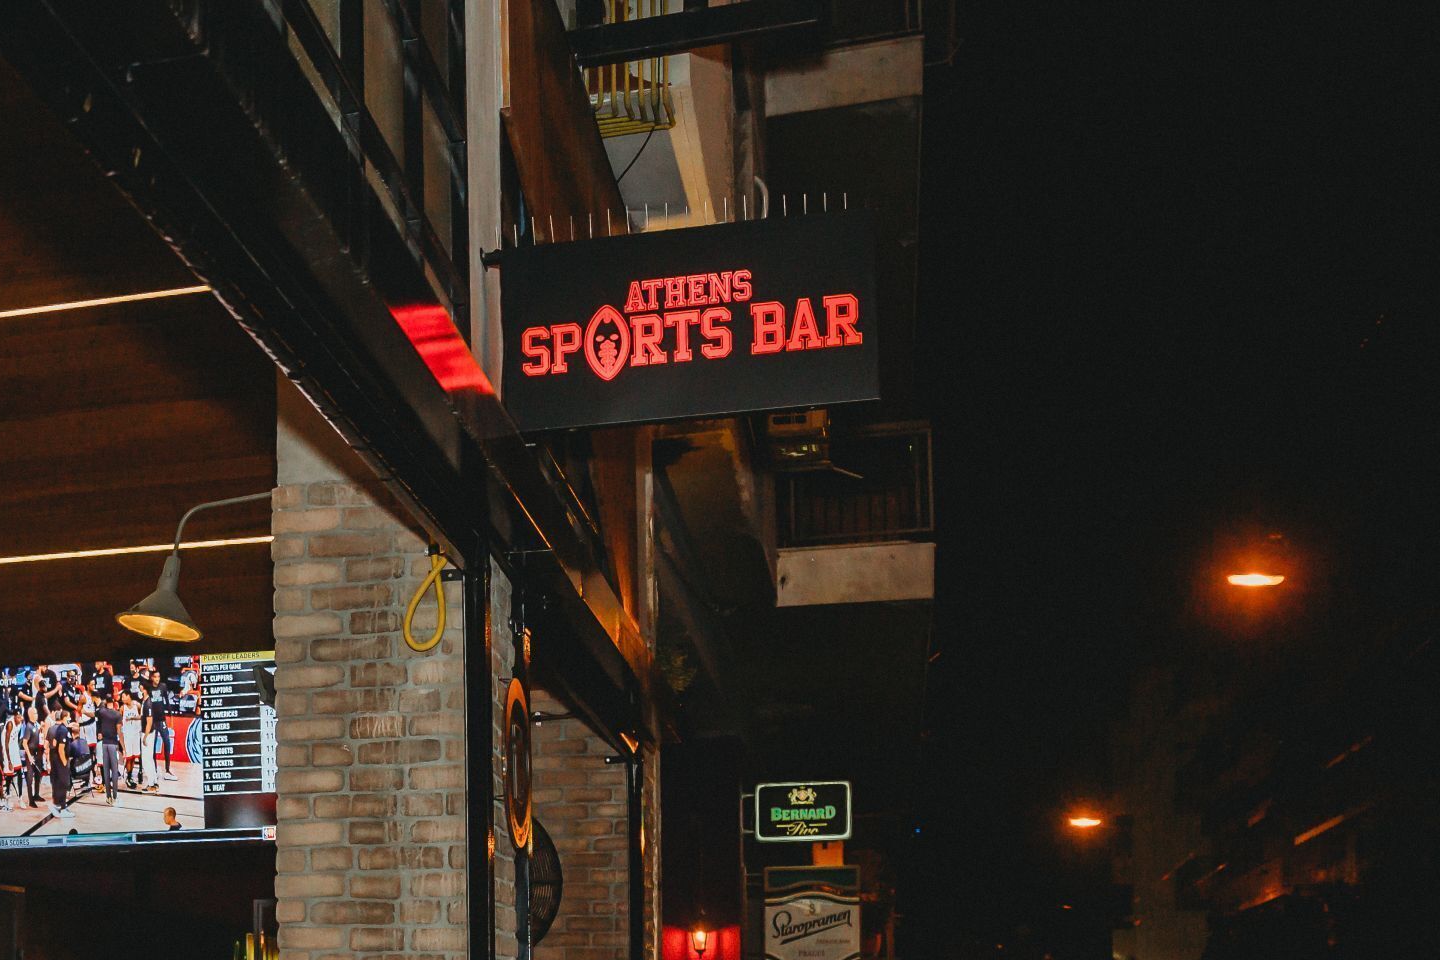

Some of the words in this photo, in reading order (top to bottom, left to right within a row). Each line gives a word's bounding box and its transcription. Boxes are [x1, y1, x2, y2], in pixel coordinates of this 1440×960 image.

[624, 269, 752, 313] ATHENS
[751, 294, 862, 355] BAR
[231, 652, 260, 660] LEADERS
[770, 805, 836, 821] BERNARD
[772, 909, 852, 942] Staropramen
